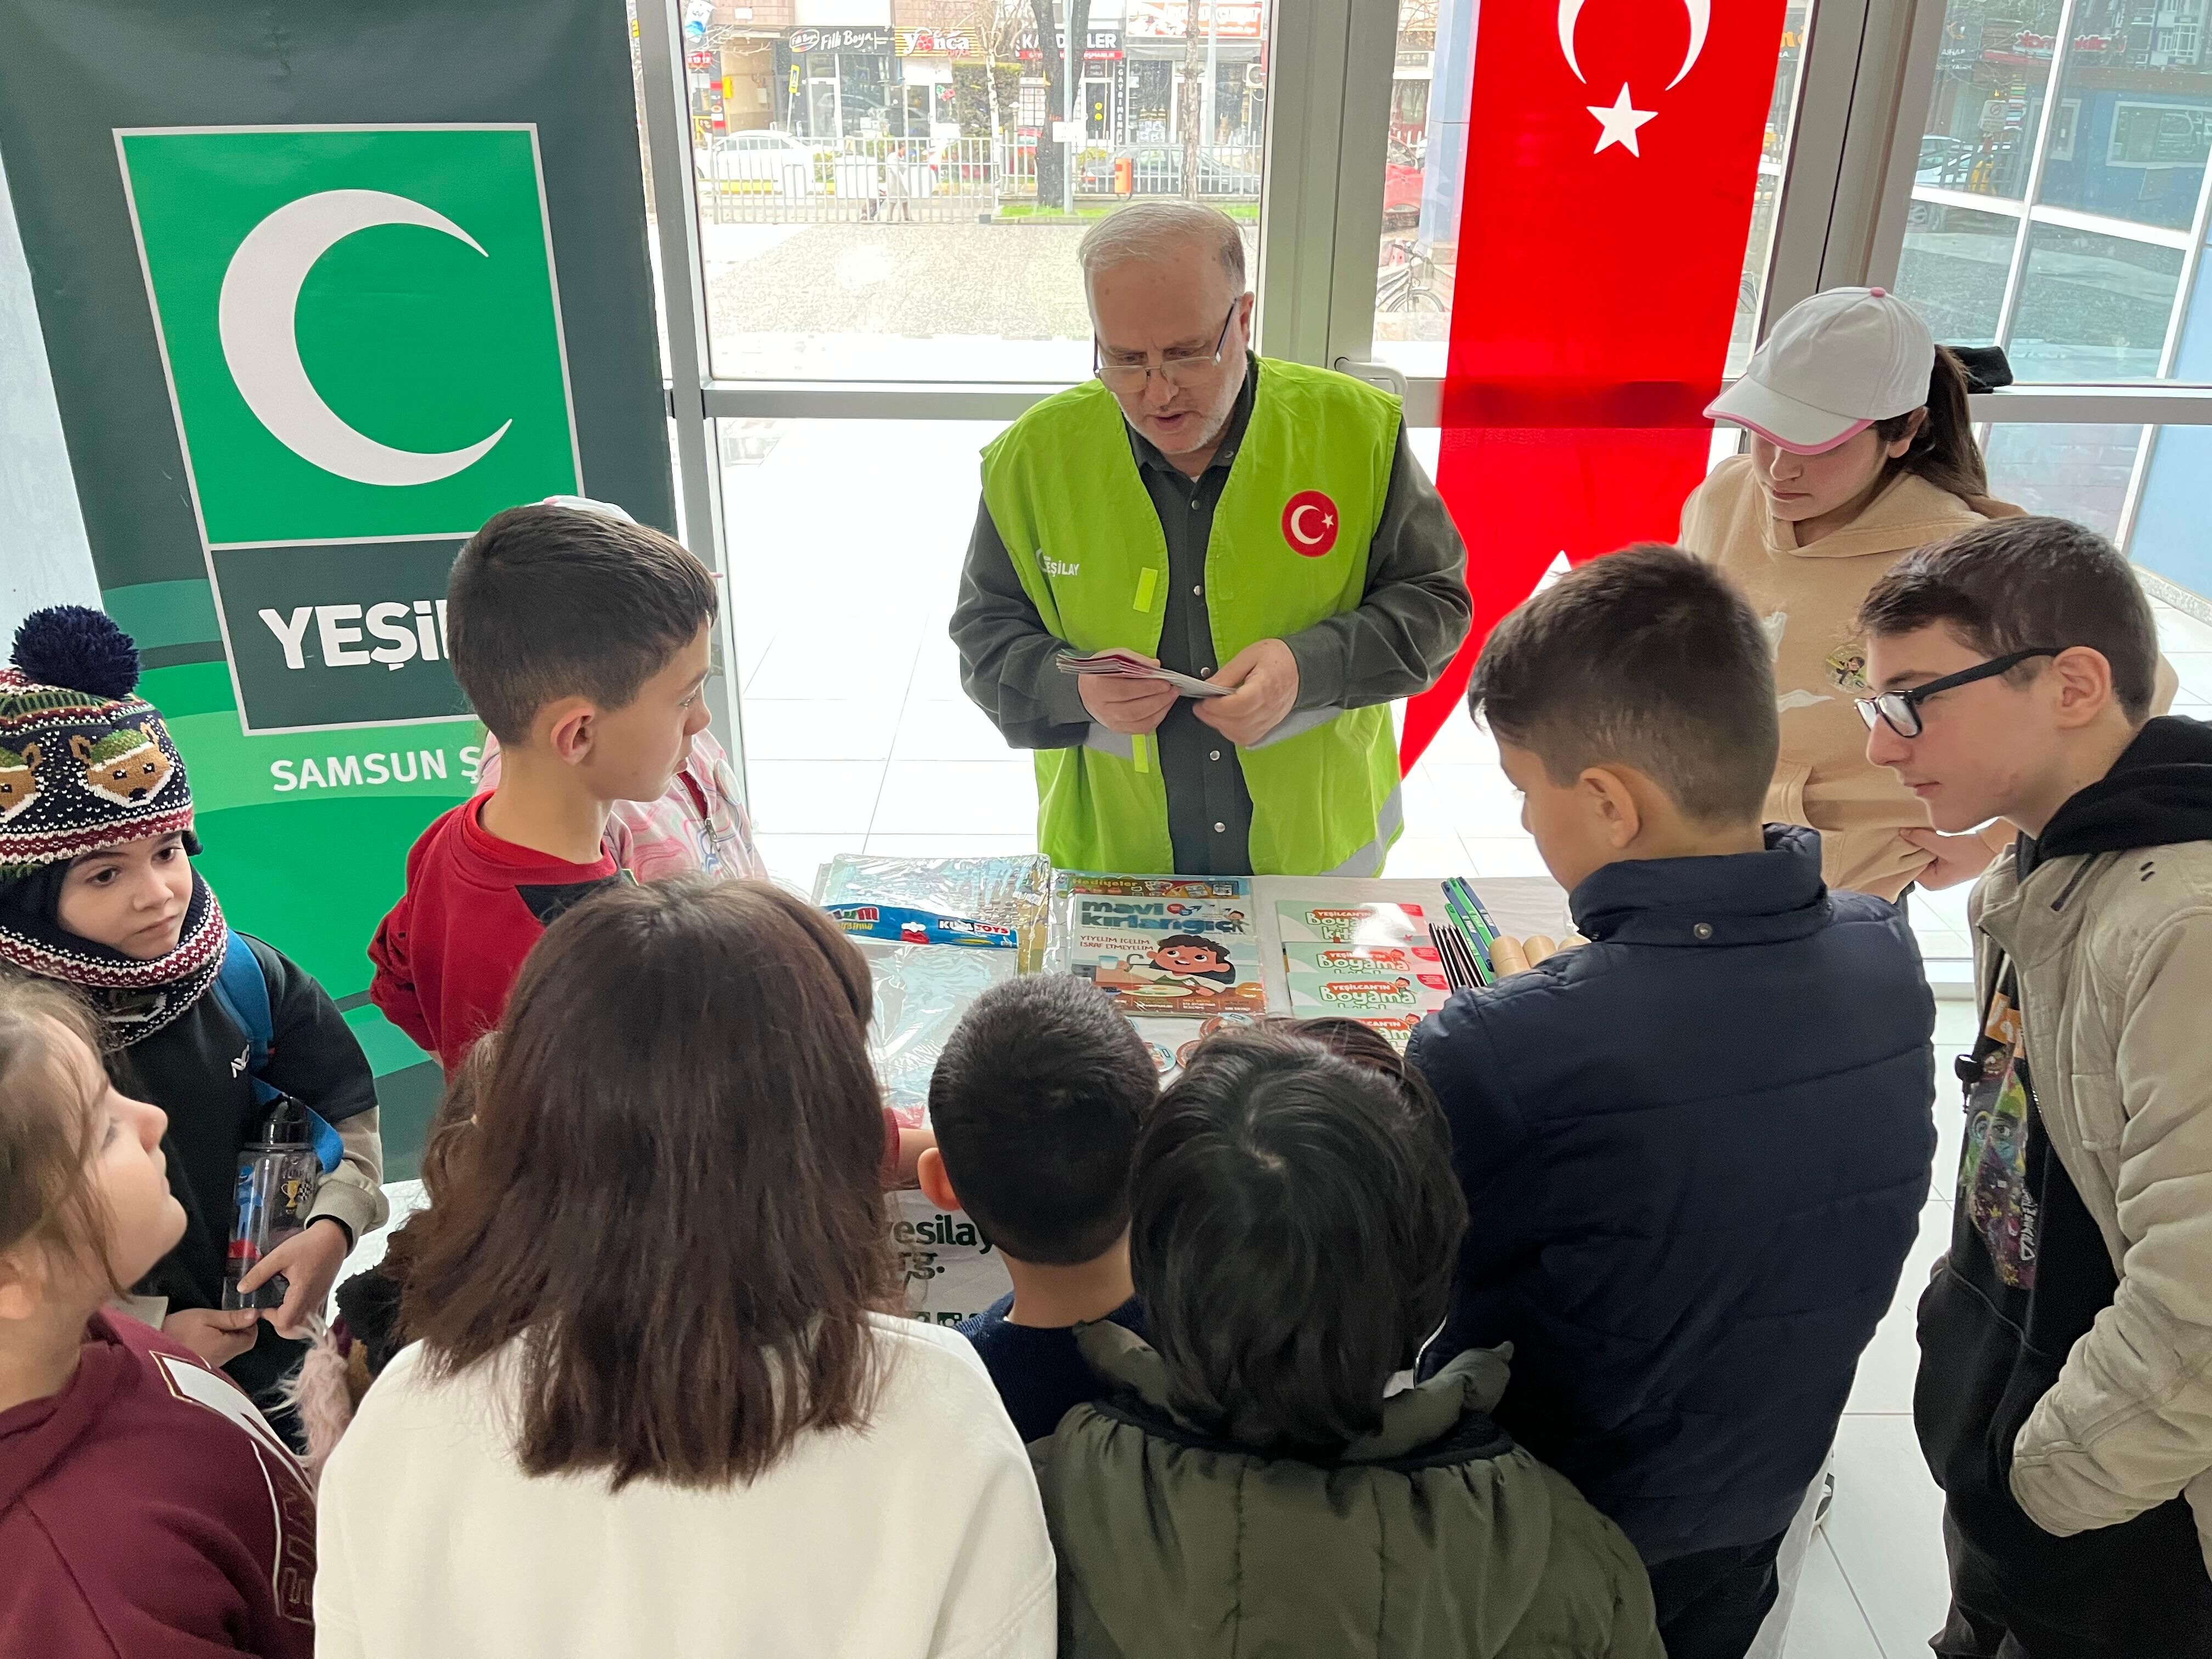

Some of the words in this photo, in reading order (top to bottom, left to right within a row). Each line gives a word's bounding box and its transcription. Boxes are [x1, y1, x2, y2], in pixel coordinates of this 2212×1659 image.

[820, 31, 842, 50] Filli
[843, 30, 874, 49] Boya
[1044, 560, 1080, 577] EŞİLAY
[270, 748, 448, 792] SAMSUN
[1082, 901, 1164, 915] mavi
[1317, 953, 1410, 970] Boyama
[1319, 985, 1417, 1005] Boyama
